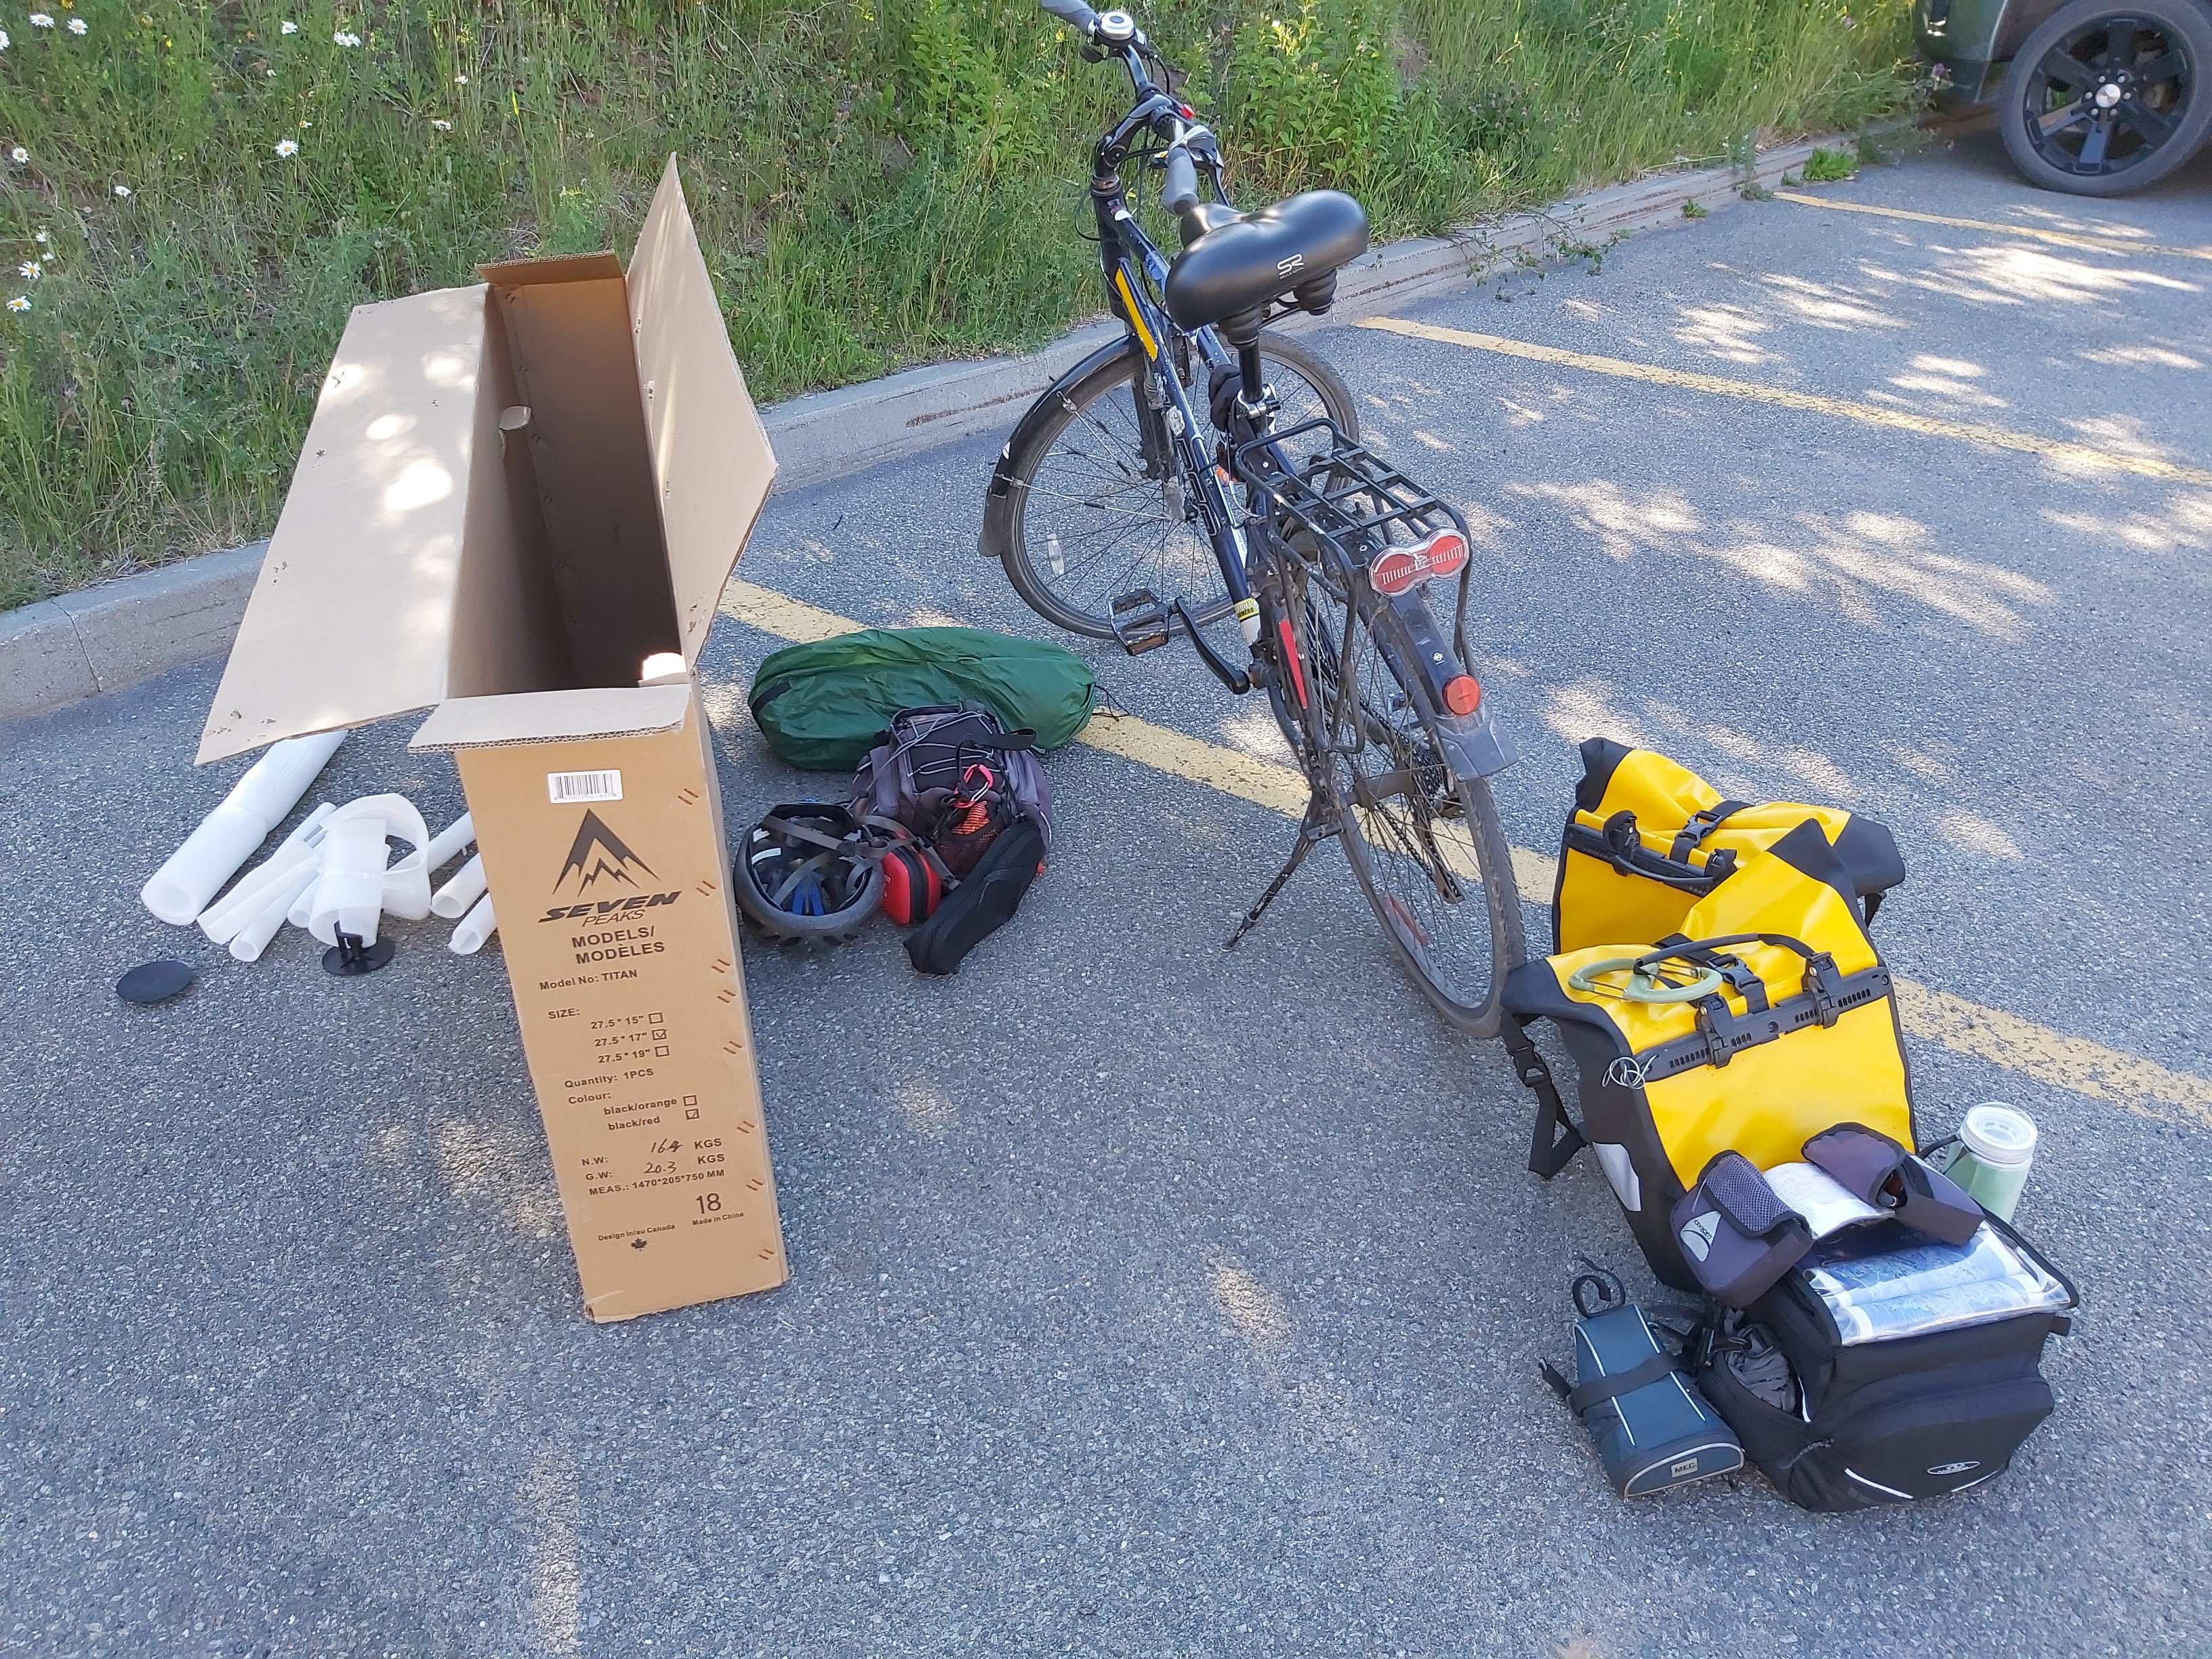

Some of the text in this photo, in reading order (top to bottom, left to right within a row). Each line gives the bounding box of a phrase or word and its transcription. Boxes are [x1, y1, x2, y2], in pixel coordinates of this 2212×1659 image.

[538, 890, 682, 922] SEVEN
[581, 909, 645, 927] PEAKS
[571, 926, 655, 948] MODELS/
[575, 941, 665, 964] MODÈLES
[539, 969, 638, 990] Model No: TITAN
[548, 1008, 581, 1019] SIZE:
[591, 1019, 615, 1029] 27.5
[594, 1036, 619, 1047] 27.5
[598, 1053, 622, 1063] 27.5
[565, 1068, 654, 1088] Quantity: 1PCS
[569, 1092, 611, 1105] Colour:
[603, 1099, 677, 1115] black/orange
[607, 1115, 661, 1131] black/red
[694, 1138, 722, 1150] KGS
[581, 1156, 609, 1166] N.W:
[697, 1153, 725, 1165] KGS
[643, 1161, 677, 1174] 20.3
[586, 1171, 613, 1181] G.W:
[589, 1184, 630, 1195] MEAS.:
[707, 1169, 724, 1178] MM
[696, 1193, 722, 1214] 18
[722, 1212, 744, 1221] China
[598, 1232, 625, 1242] Design
[647, 1224, 676, 1233] Canada
[1675, 1462, 1695, 1473] MEC
